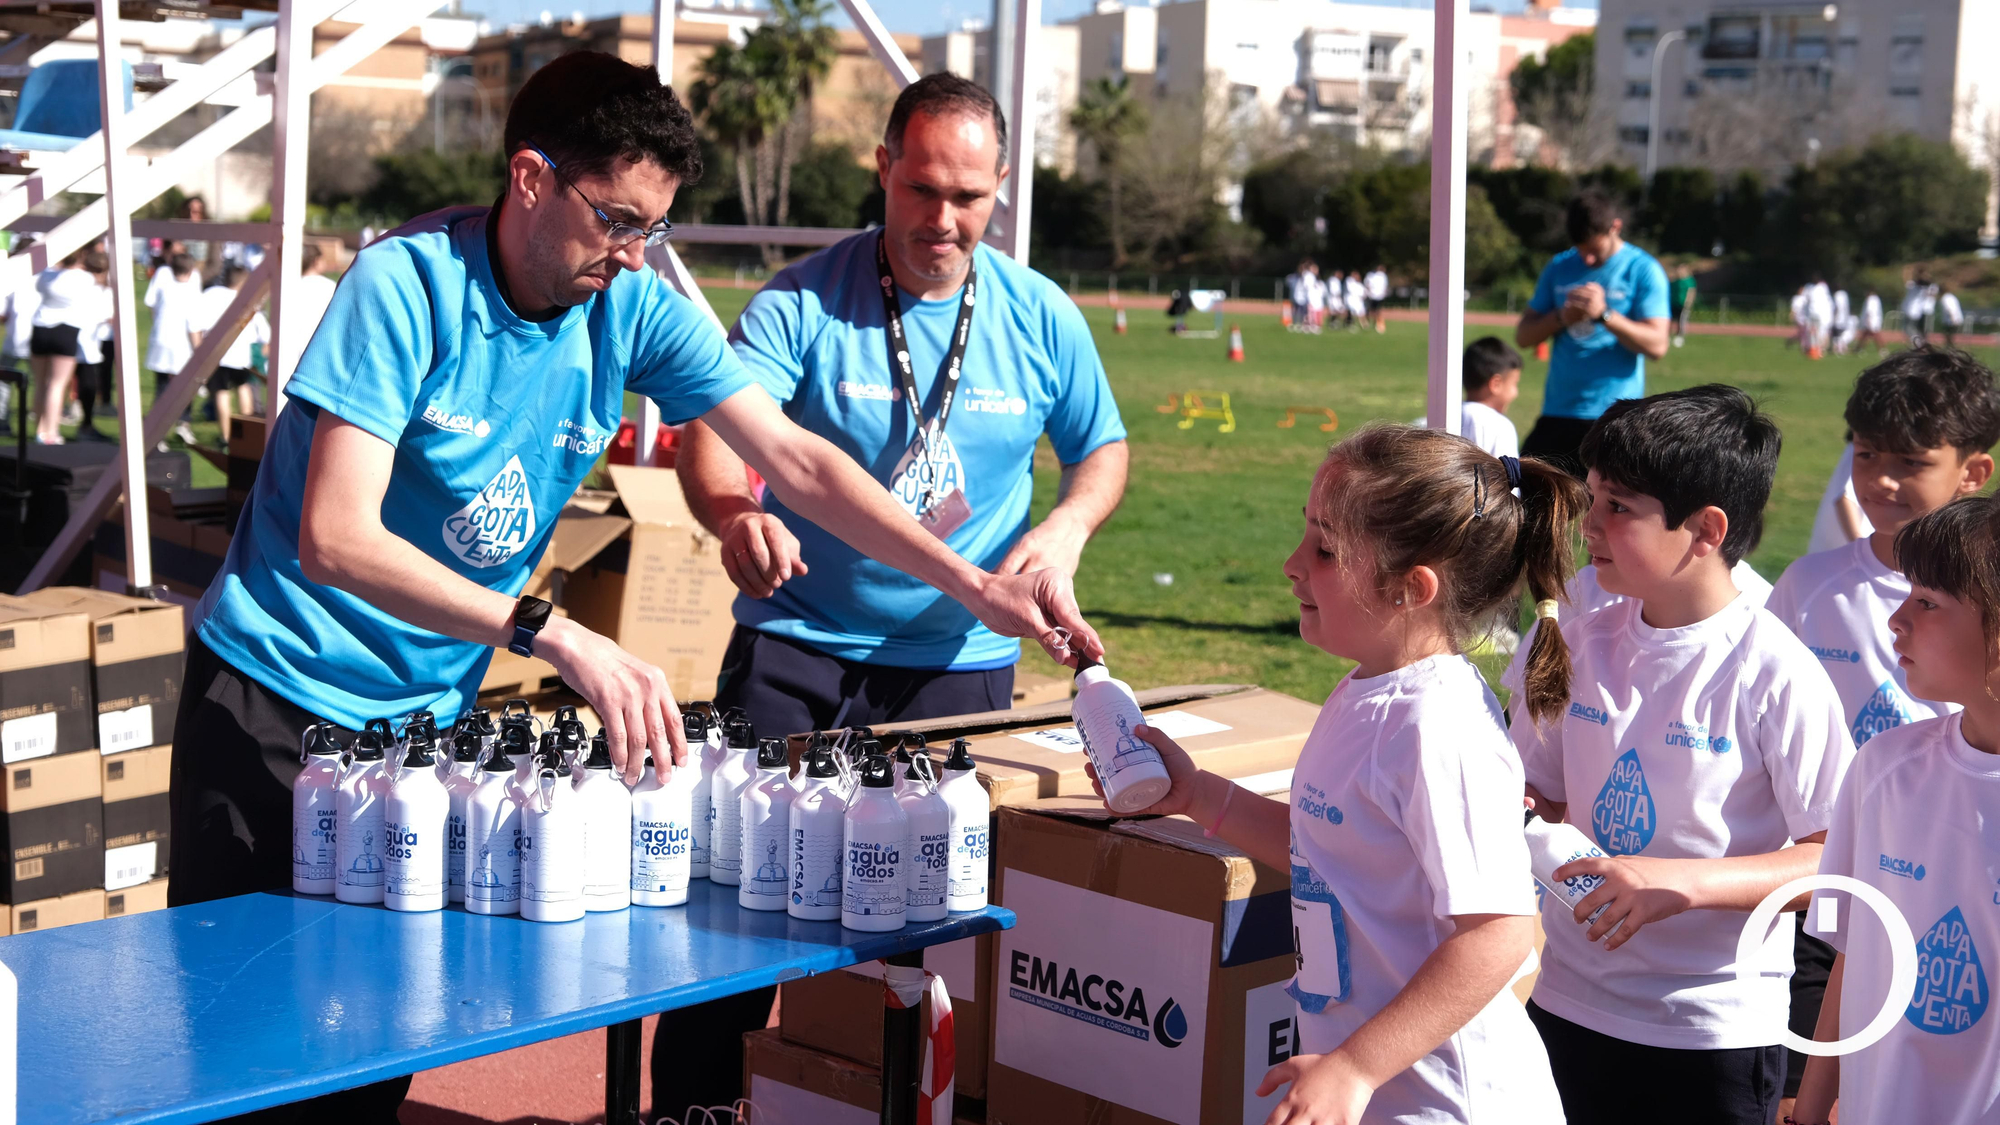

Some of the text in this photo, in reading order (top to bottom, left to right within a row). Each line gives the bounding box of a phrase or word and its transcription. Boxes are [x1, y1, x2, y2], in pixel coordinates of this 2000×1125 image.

[964, 396, 1011, 414] unicef
[423, 405, 474, 431] EMACSA
[553, 433, 604, 455] unicef
[906, 459, 958, 492] GOTA
[482, 470, 526, 506] CADA
[468, 505, 529, 543] GOTA
[446, 516, 511, 564] CUENTA
[1867, 688, 1905, 716] CADA
[1675, 720, 1695, 731] favor
[1665, 732, 1713, 751] unicef
[1610, 760, 1642, 794] CADA
[1298, 795, 1327, 820] unicef
[1604, 787, 1650, 831] GOTA
[312, 829, 324, 837] de
[401, 826, 410, 834] el
[640, 821, 668, 829] EMACSA
[1593, 800, 1642, 853] CUENTA
[385, 833, 418, 847] gua
[635, 839, 686, 856] de todos
[640, 827, 689, 847] agua
[848, 840, 893, 853] EMACSA el
[920, 834, 946, 842] EMACSA
[795, 828, 804, 890] EMACSA
[848, 849, 900, 869] agua
[851, 865, 895, 878] todos
[1298, 880, 1326, 894] unicef
[1568, 886, 1577, 897] de
[1924, 921, 1971, 961] CADA
[1010, 949, 1149, 1027] EMACSA
[1917, 952, 1981, 1004] GOTA
[1010, 989, 1035, 1004] EMPRESA
[1036, 997, 1066, 1014] MUNICIPAL
[1067, 1008, 1075, 1017] DE
[1076, 1012, 1096, 1024] AGUAS
[1096, 1017, 1104, 1026] DE
[1136, 1030, 1148, 1039] S.A.
[1911, 979, 1971, 1030] UENTA
